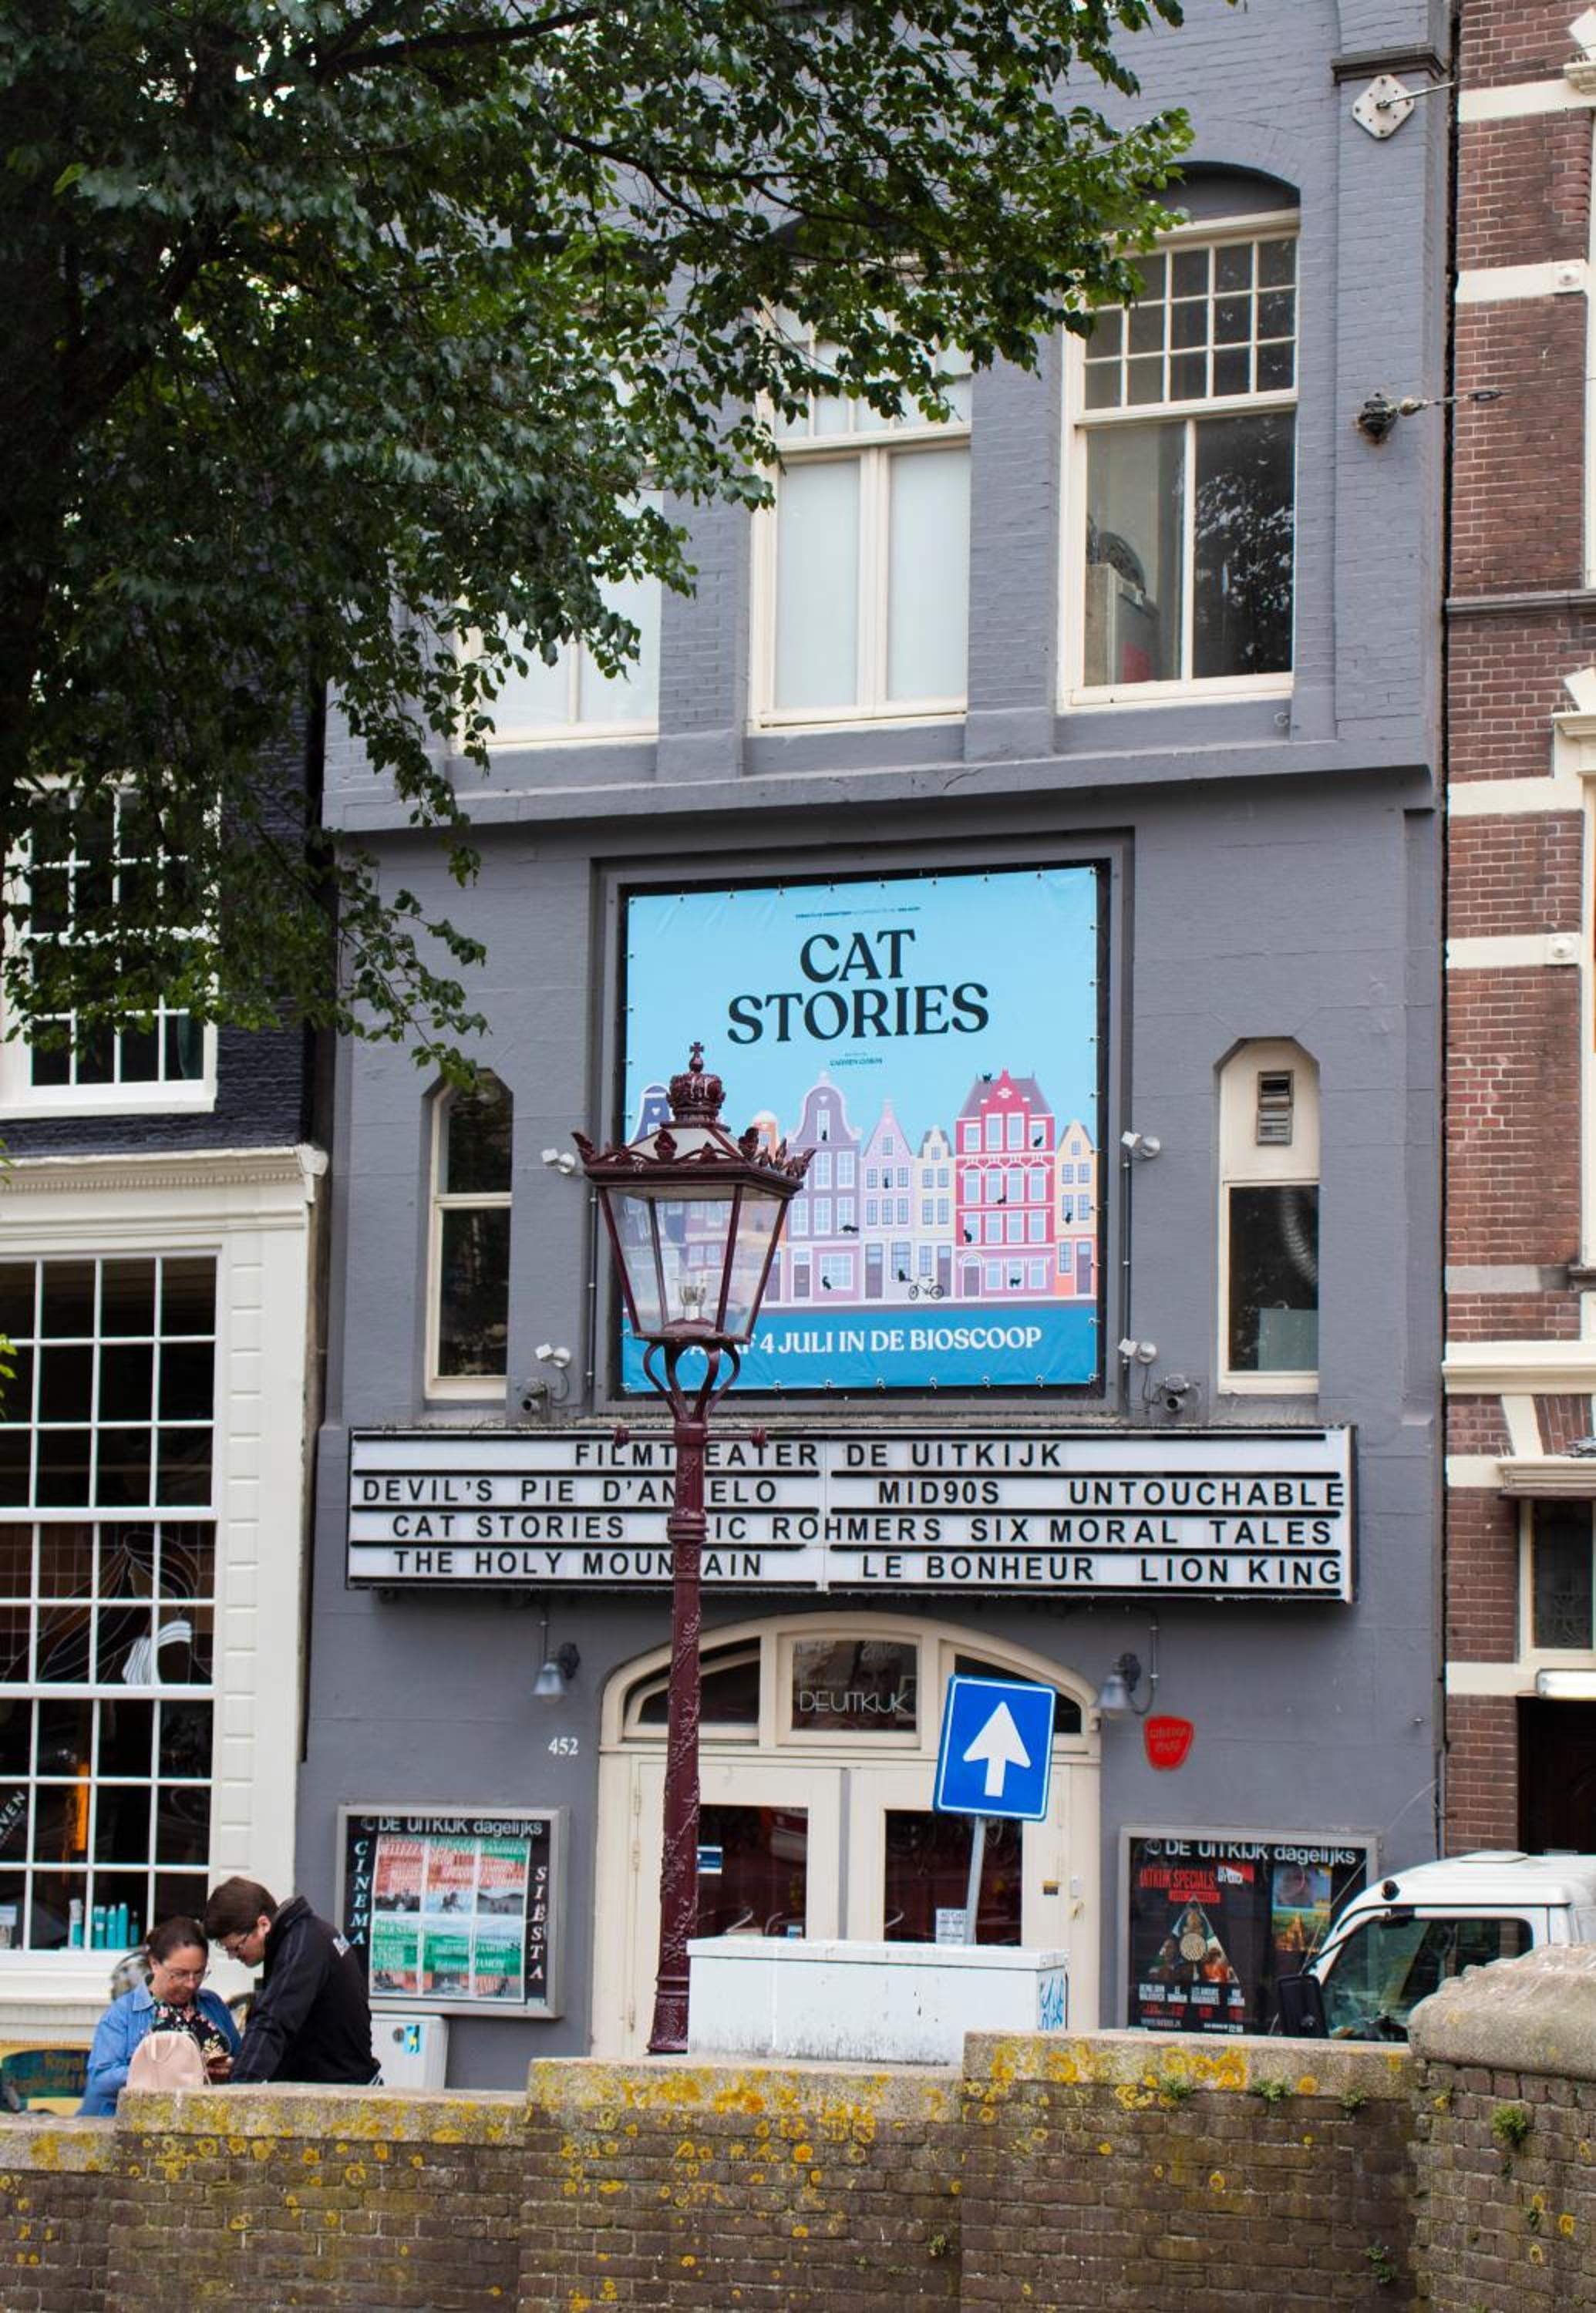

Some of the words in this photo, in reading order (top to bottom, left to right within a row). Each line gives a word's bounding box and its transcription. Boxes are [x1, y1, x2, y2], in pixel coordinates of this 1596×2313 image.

[800, 929, 915, 983] CAT
[727, 983, 988, 1045] STORIES
[759, 1333, 774, 1353] 4
[778, 1332, 833, 1353] JULI
[839, 1331, 864, 1352] IN
[870, 1329, 904, 1352] DE
[910, 1327, 1042, 1351] BIOSCOOP
[574, 1443, 817, 1467] FILMTEATER
[847, 1443, 887, 1467] DE
[911, 1443, 1060, 1467] UITKIJK
[362, 1478, 493, 1503] DEVIL'S
[521, 1479, 574, 1503] PIE
[603, 1479, 776, 1503] D'ANELO
[878, 1480, 999, 1505] MID90S
[1069, 1480, 1344, 1507] UNTOUCHABLE
[392, 1514, 456, 1538] CAT
[476, 1514, 624, 1539] STORIES
[772, 1517, 941, 1542] ROHMERS
[971, 1518, 1029, 1543] SIX
[1050, 1519, 1178, 1544] MORAL
[1209, 1520, 1331, 1545] TALES
[394, 1550, 453, 1574] THE
[475, 1551, 563, 1574] HOLY
[583, 1552, 761, 1577] MOUNAIN
[863, 1555, 901, 1578] LE
[927, 1555, 1093, 1581] BONHEUR
[1140, 1557, 1228, 1583] LION
[1248, 1559, 1342, 1585] KING
[548, 1736, 578, 1756] 452
[379, 1817, 401, 1831] DE
[473, 1819, 543, 1837] dagelijks
[1165, 1840, 1191, 1857] DE
[1274, 1845, 1356, 1866] dagelijks
[349, 1840, 371, 1945] CINEMA
[529, 1866, 548, 1980] SIESTA
